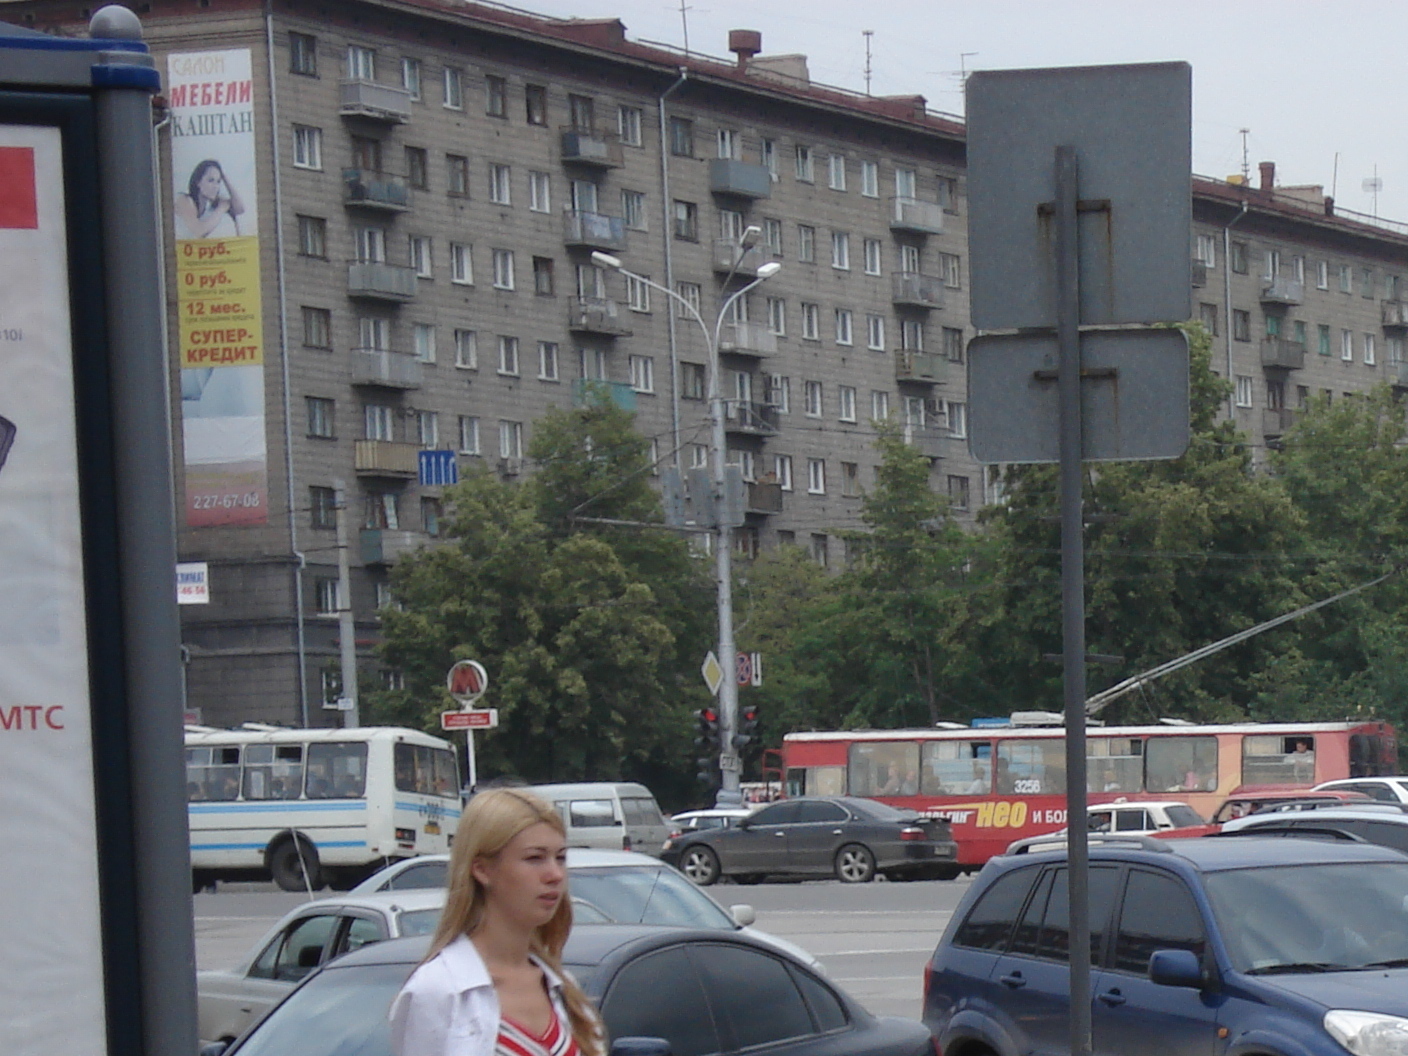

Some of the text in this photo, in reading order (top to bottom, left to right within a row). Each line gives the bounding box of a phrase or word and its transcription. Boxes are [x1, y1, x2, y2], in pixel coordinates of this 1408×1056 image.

[172, 56, 226, 76] САЛОН
[171, 80, 252, 108] МЕБЕЛИ
[172, 111, 253, 137] КАШТАН
[198, 242, 231, 259] руб.
[199, 270, 232, 288] руб.
[186, 302, 246, 315] 12 мес.
[189, 328, 254, 345] СУПЕР-
[186, 346, 258, 364] КРЕДИТ
[0, 705, 65, 730] МТС
[1045, 810, 1068, 823] БОЛ
